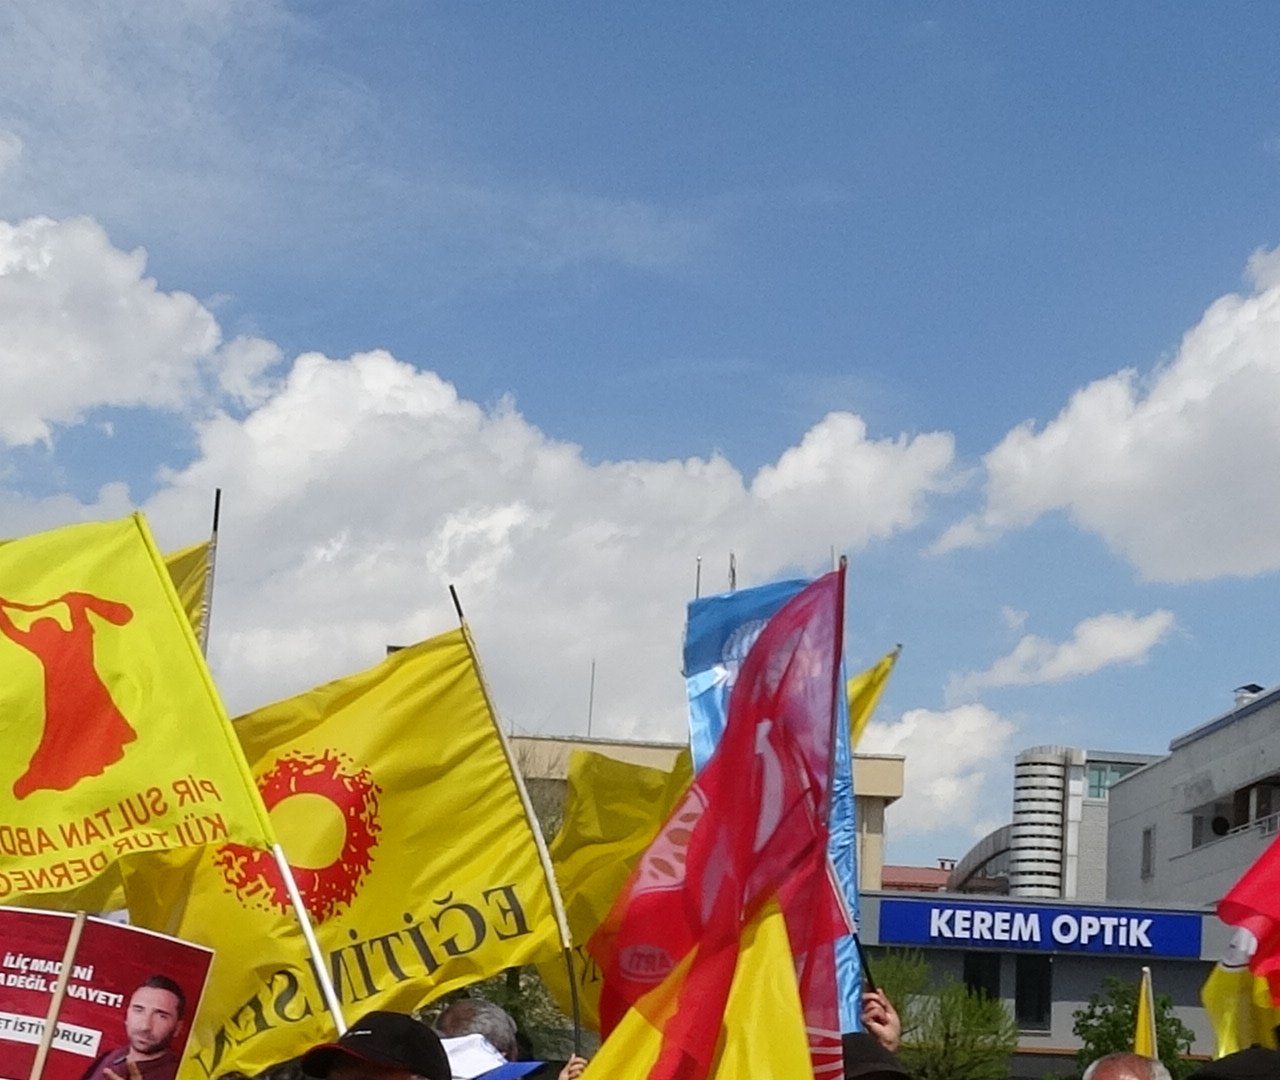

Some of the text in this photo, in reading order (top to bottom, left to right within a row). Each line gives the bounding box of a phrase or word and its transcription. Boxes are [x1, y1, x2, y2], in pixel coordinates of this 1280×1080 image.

[929, 908, 1041, 943] KEREM
[30, 958, 94, 981] MADNİ
[5, 973, 48, 992] DEĞİL
[49, 982, 124, 1008] CNAYET!
